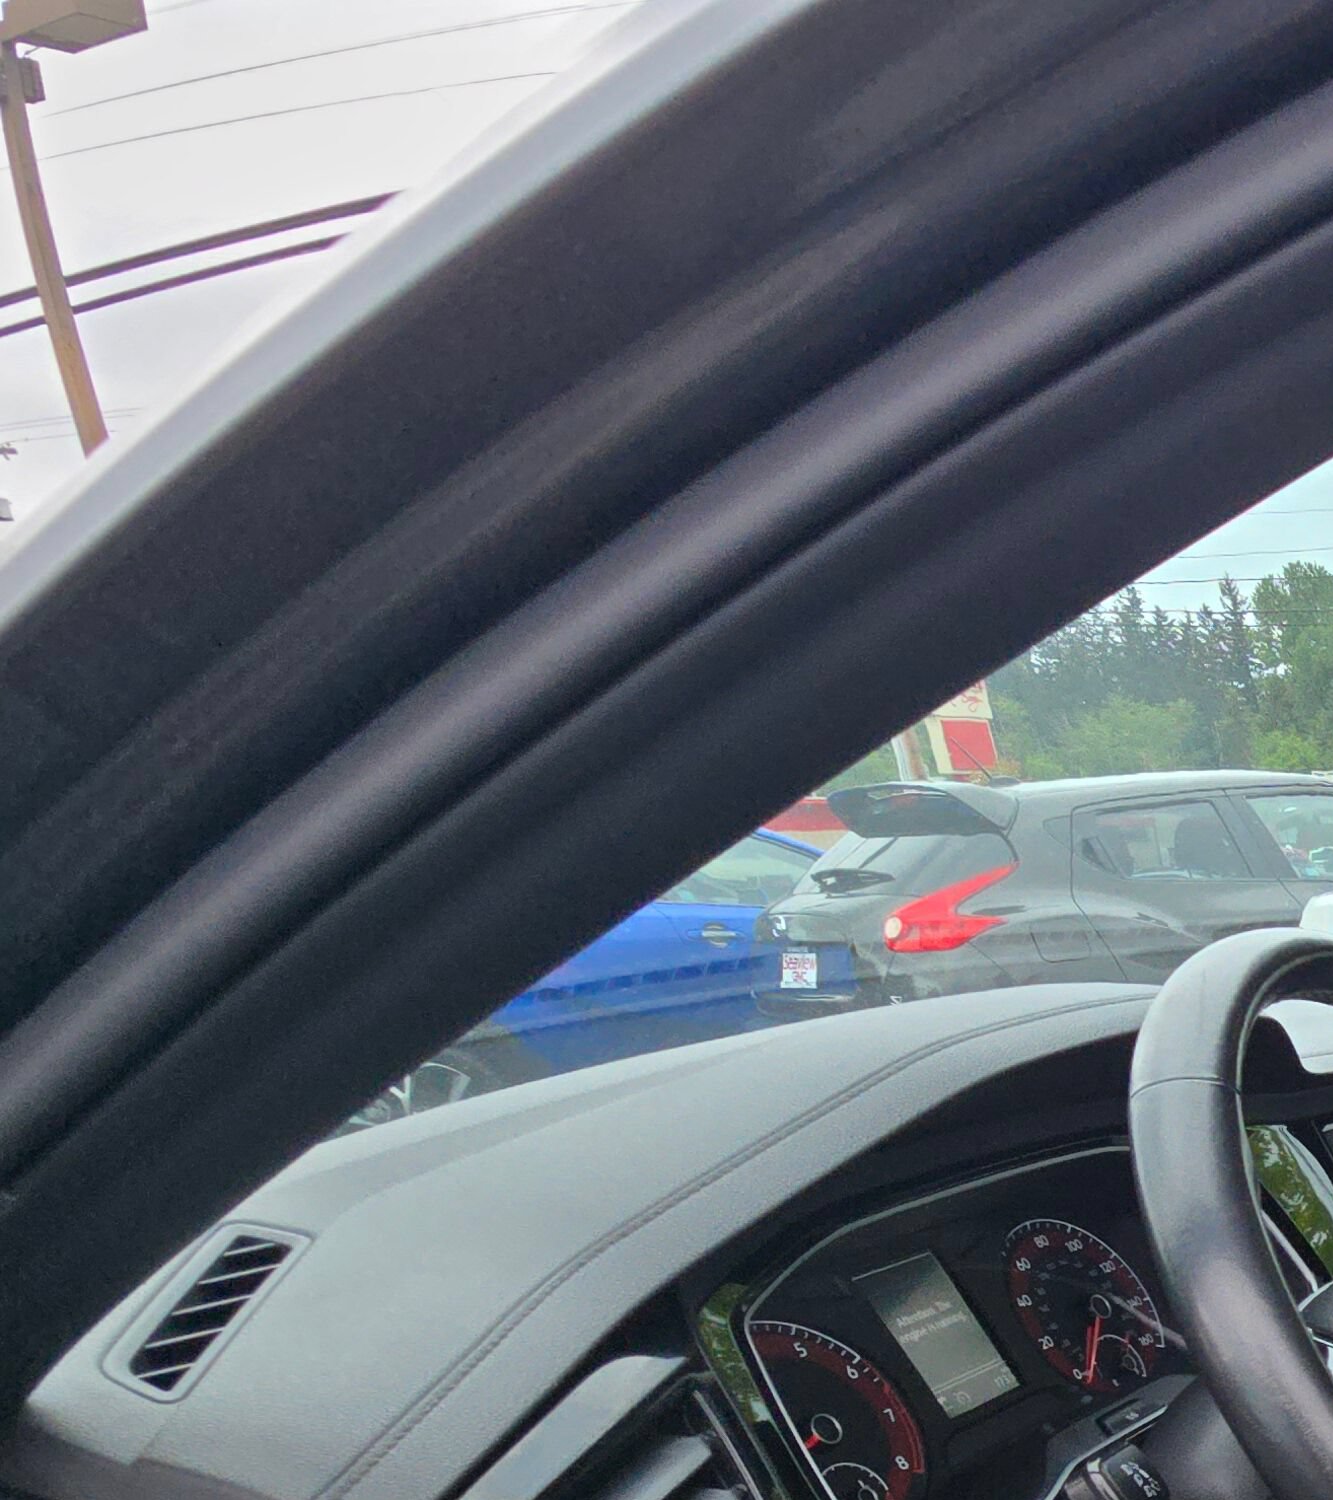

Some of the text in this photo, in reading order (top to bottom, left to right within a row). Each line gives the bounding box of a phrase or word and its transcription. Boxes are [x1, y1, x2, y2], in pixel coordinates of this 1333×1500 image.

[1033, 1235, 1049, 1249] 80
[1065, 1238, 1083, 1252] 100
[1015, 1257, 1032, 1272] 60
[1099, 1259, 1117, 1274] 120
[1016, 1293, 1033, 1308] 40
[1038, 1335, 1054, 1350] 20
[1138, 1332, 1154, 1347] 160
[794, 1341, 809, 1358] 5
[846, 1365, 859, 1379] 6
[1072, 1367, 1083, 1380] 0
[882, 1408, 896, 1423] 7
[895, 1455, 910, 1470] 8
